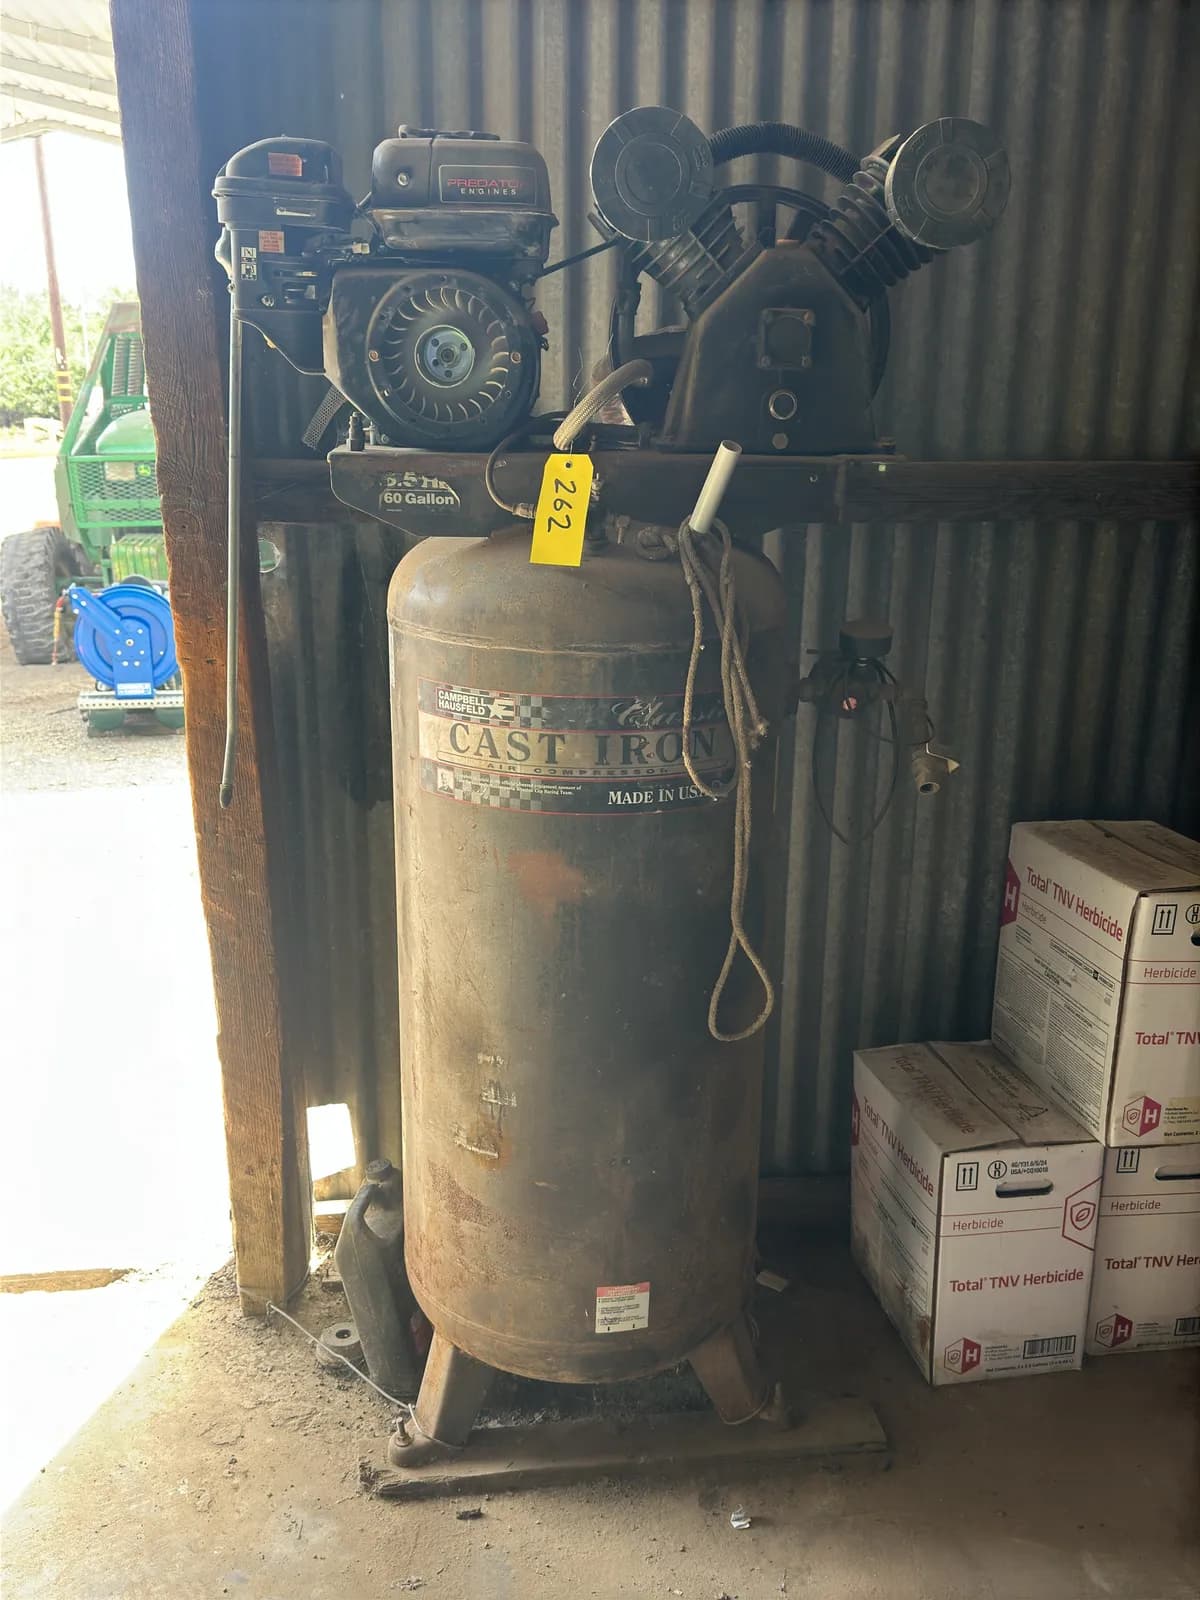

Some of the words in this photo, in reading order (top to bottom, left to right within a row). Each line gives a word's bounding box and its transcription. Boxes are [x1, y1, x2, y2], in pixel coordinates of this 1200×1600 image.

[460, 187, 517, 195] ENGINES
[384, 492, 402, 504] 60
[404, 493, 455, 504] Gallon
[547, 478, 577, 533] 262
[438, 690, 487, 707] CAMPBELL
[438, 700, 486, 715] HAUSFELD
[450, 722, 566, 765] CAST
[595, 727, 718, 766] IRON
[487, 763, 516, 771] AIR
[608, 791, 654, 805] MADE
[658, 788, 675, 802] IN
[679, 784, 704, 800] US
[1005, 881, 1017, 912] H
[1053, 882, 1075, 909] TNV
[1076, 897, 1123, 941] Herbicide
[1143, 967, 1197, 979] Herbicide
[1144, 1108, 1158, 1124] H
[881, 1119, 898, 1151] TNV
[897, 1141, 935, 1198] Herbicide
[1110, 1200, 1161, 1211] Herbicide
[952, 1218, 1004, 1231] Herbicide
[1143, 1255, 1174, 1268] TNV
[1176, 1253, 1200, 1267] Her
[989, 1274, 1020, 1289] TNV
[1023, 1268, 1084, 1286] Herbicide
[1115, 1324, 1129, 1338] H
[965, 1348, 978, 1363] H
